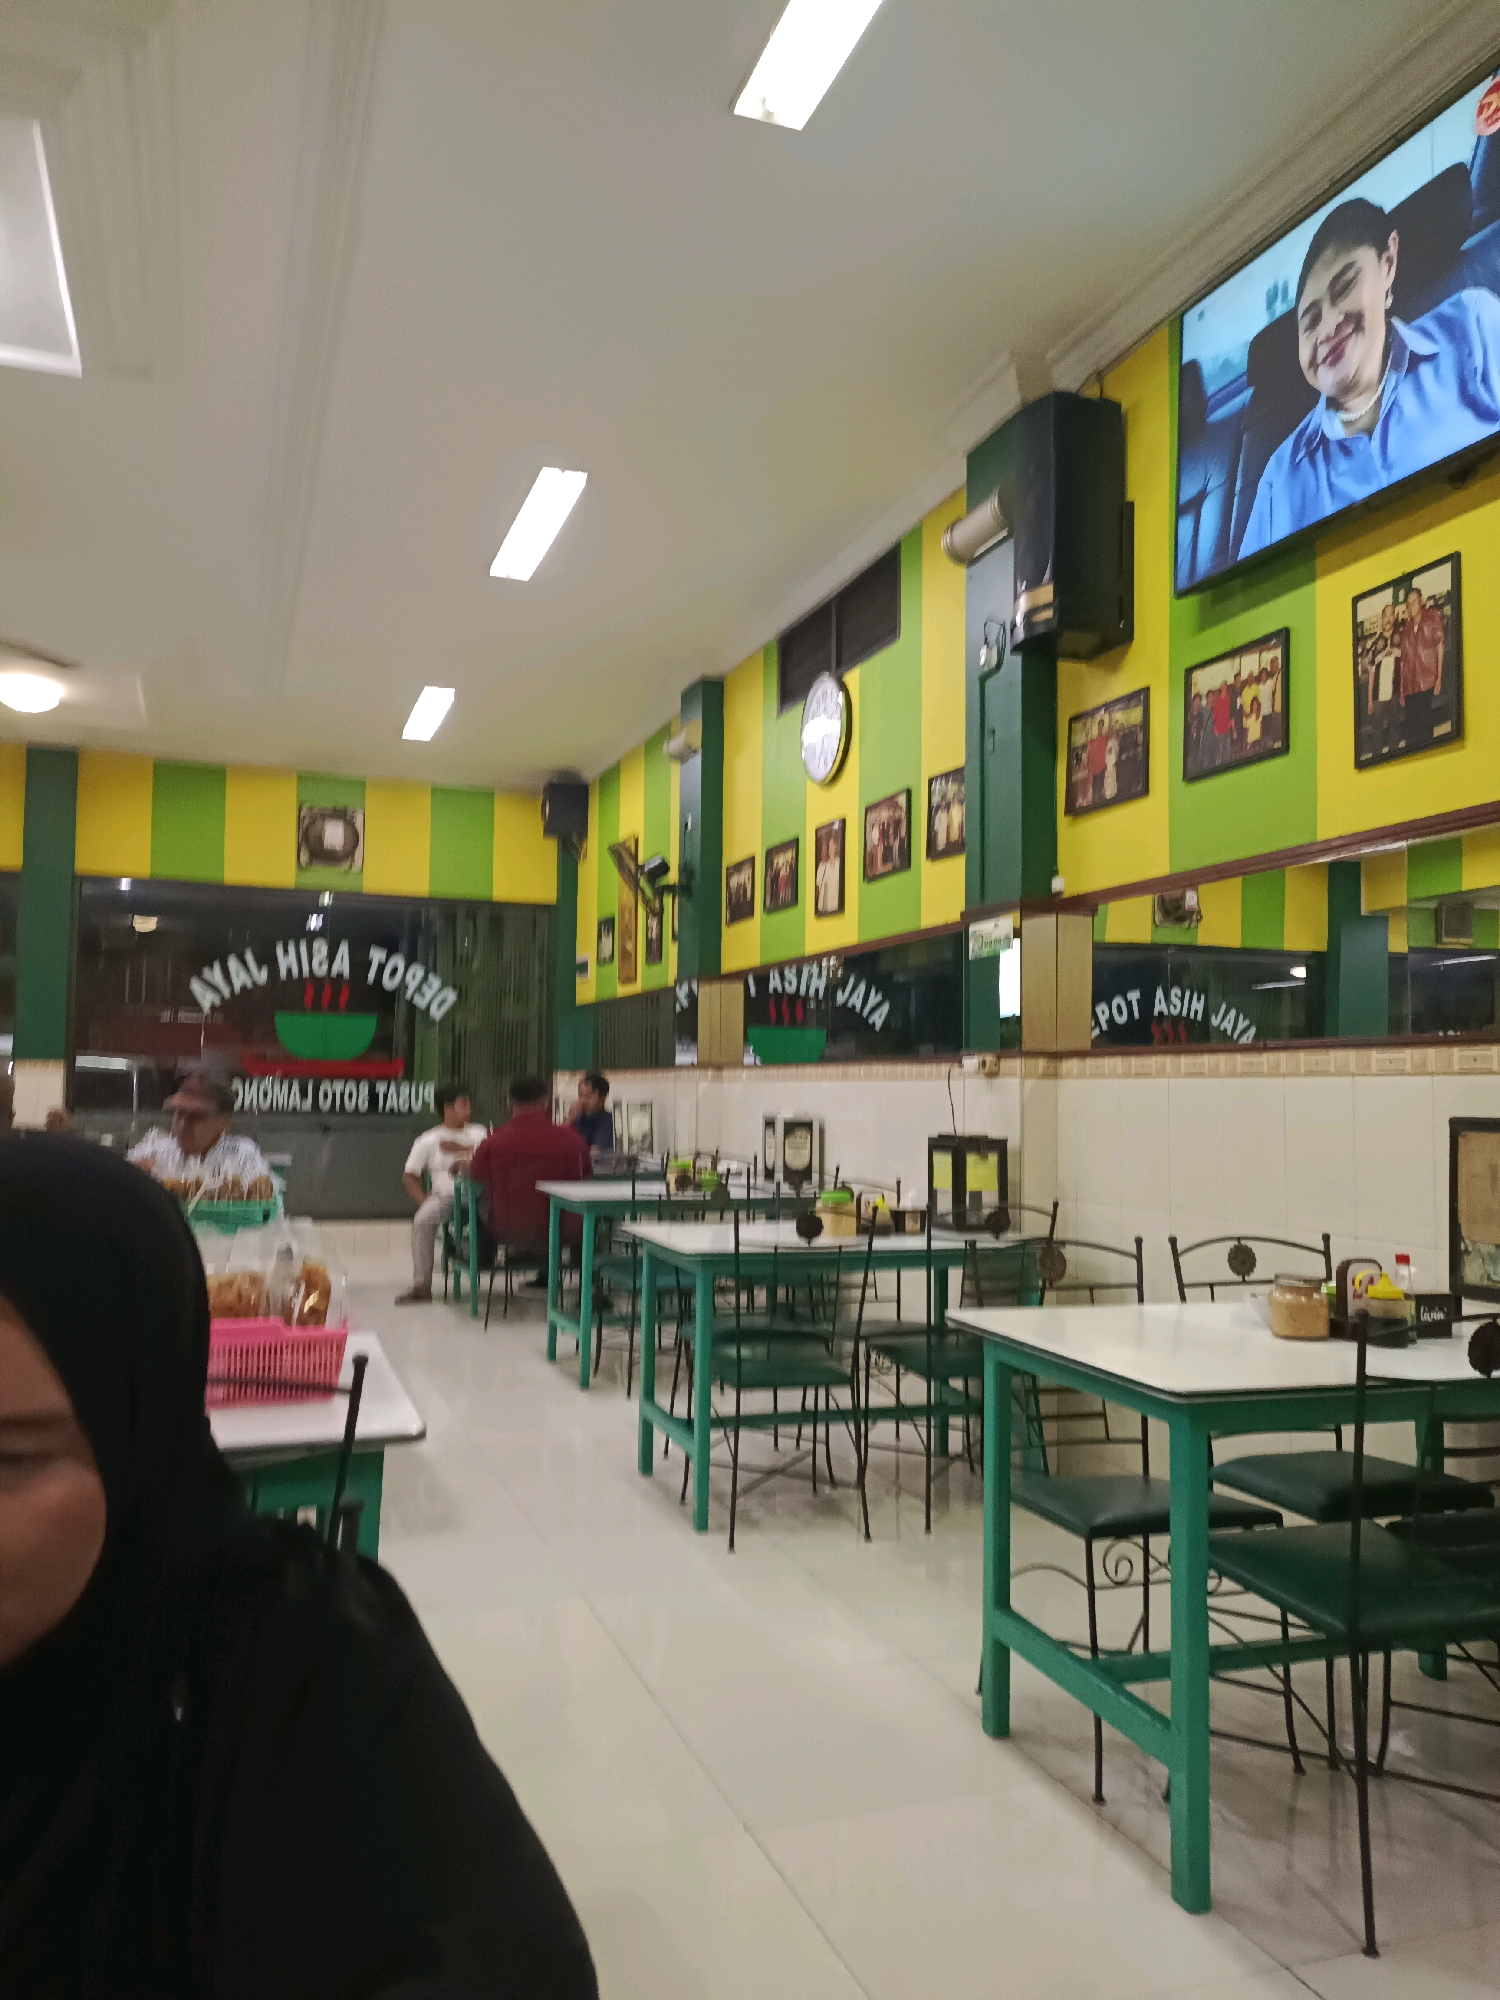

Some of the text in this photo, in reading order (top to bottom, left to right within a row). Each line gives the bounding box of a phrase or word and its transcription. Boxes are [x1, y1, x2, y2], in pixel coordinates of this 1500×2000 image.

[769, 960, 828, 1001] ASIH
[836, 973, 891, 1033] JAYA
[1153, 984, 1205, 1021] ASIH
[1210, 1001, 1257, 1044] JAYA
